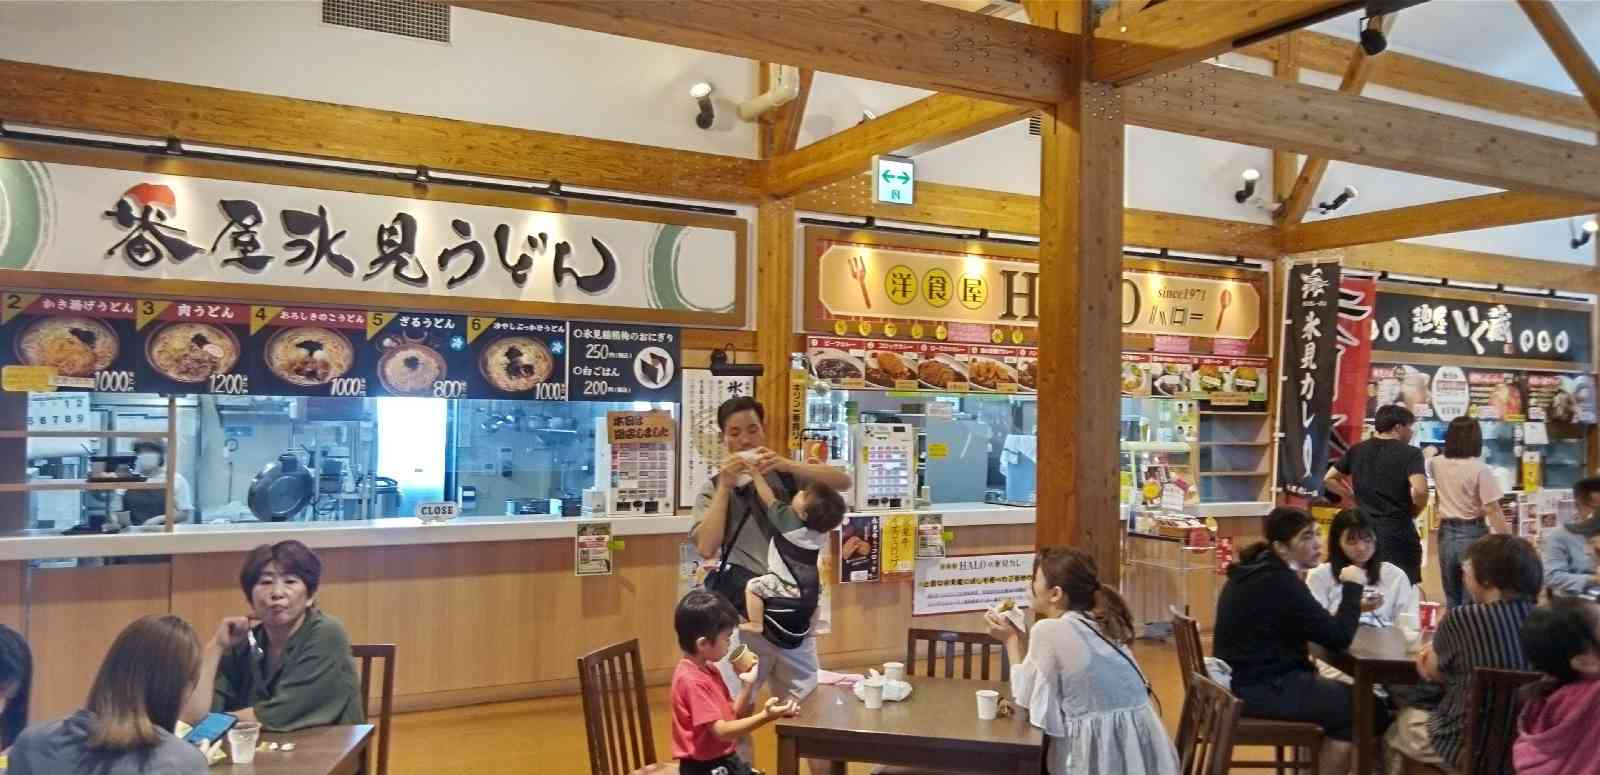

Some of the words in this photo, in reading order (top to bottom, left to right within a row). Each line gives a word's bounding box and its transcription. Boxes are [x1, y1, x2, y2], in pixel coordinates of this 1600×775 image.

[892, 270, 985, 304] 洋食屋
[7, 295, 20, 309] 2
[42, 299, 134, 314] かき揚げうどん
[142, 301, 154, 315] 3
[177, 303, 234, 319] 肉うどん
[255, 307, 266, 321] 4
[279, 310, 365, 324] おろしきのこうどん
[1148, 305, 1204, 327] ハロー
[372, 312, 384, 326] 5
[399, 315, 456, 330] ざるうどん
[471, 317, 482, 331] 6
[582, 366, 620, 377] 白ごはん
[93, 370, 129, 392] 1000
[209, 374, 243, 394] 1200
[329, 378, 361, 396] 1000
[433, 380, 462, 398] 800
[535, 382, 562, 401] 1000
[421, 505, 454, 515] CLOSE
